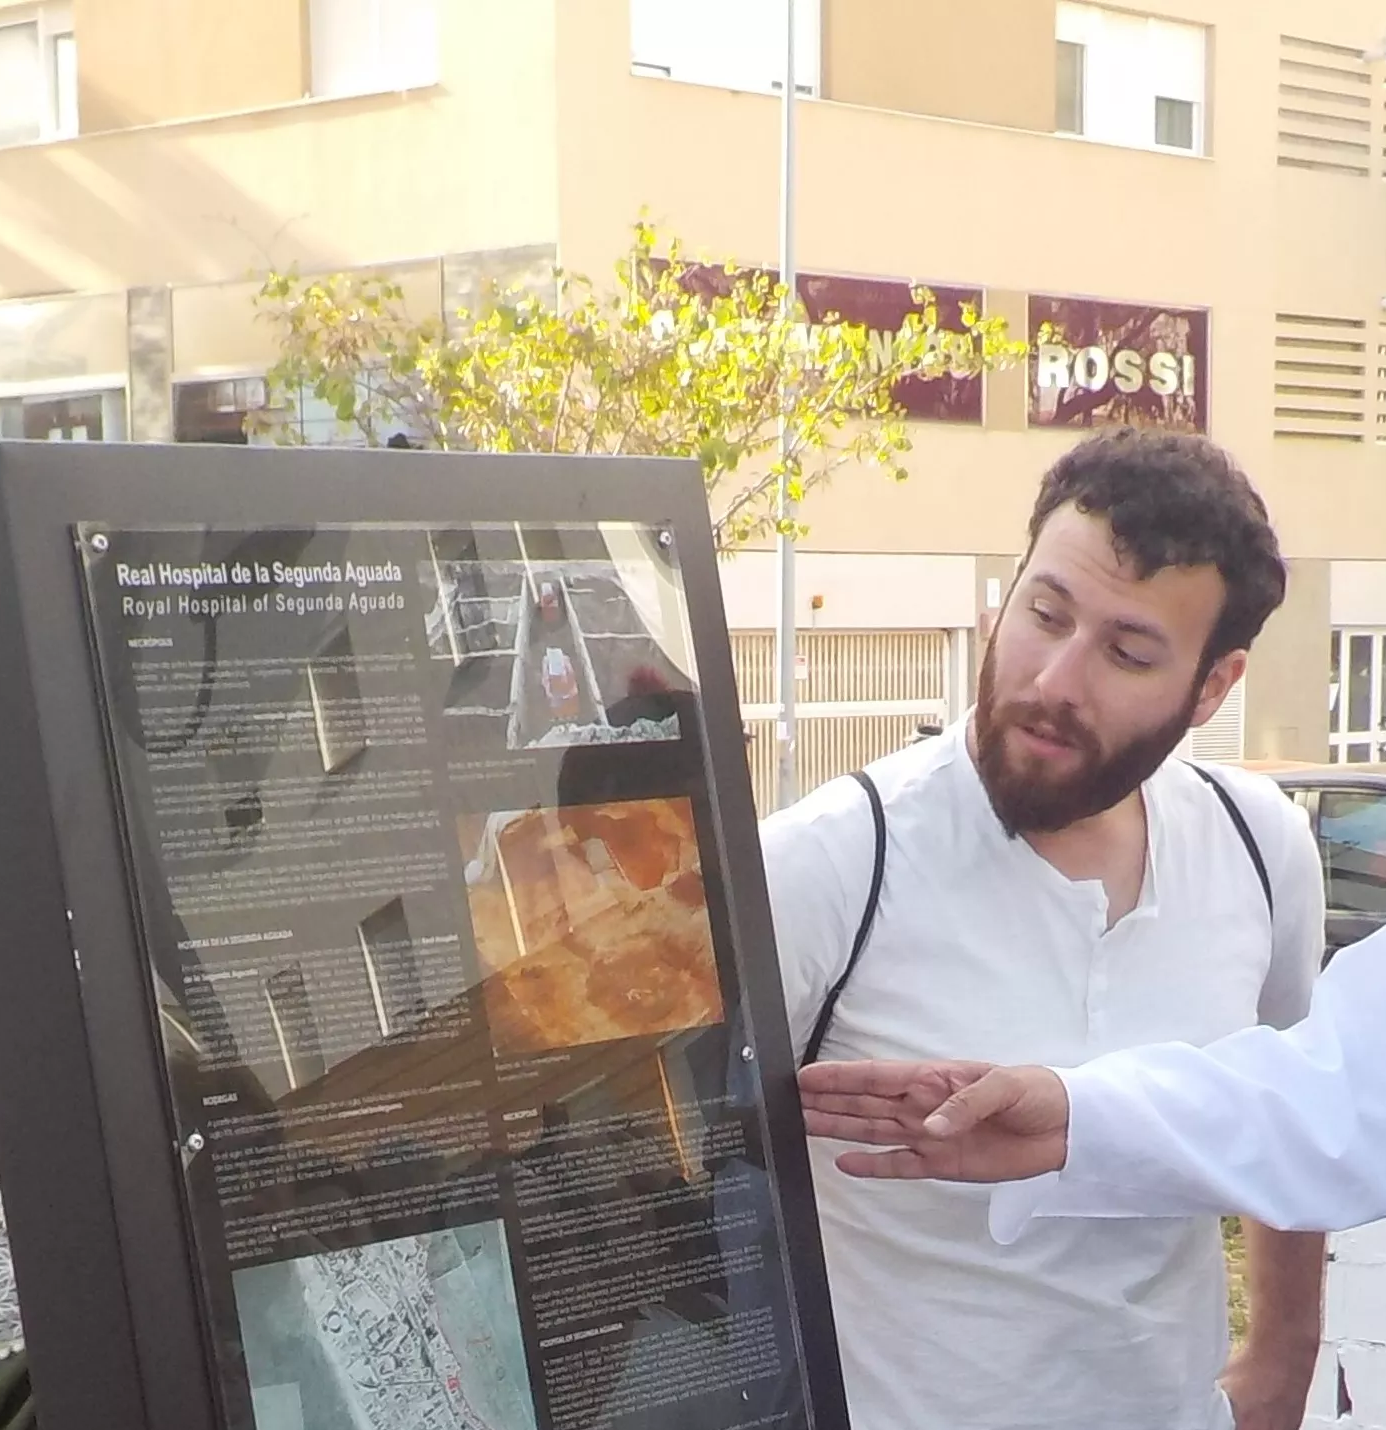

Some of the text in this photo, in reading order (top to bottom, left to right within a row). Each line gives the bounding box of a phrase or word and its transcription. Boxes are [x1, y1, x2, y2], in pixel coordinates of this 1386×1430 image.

[1037, 343, 1195, 396] ROSSI
[116, 559, 402, 590] Real Hospital de la Segunda Aguada
[122, 591, 405, 621] Royal Hospital of Segunda Aguada
